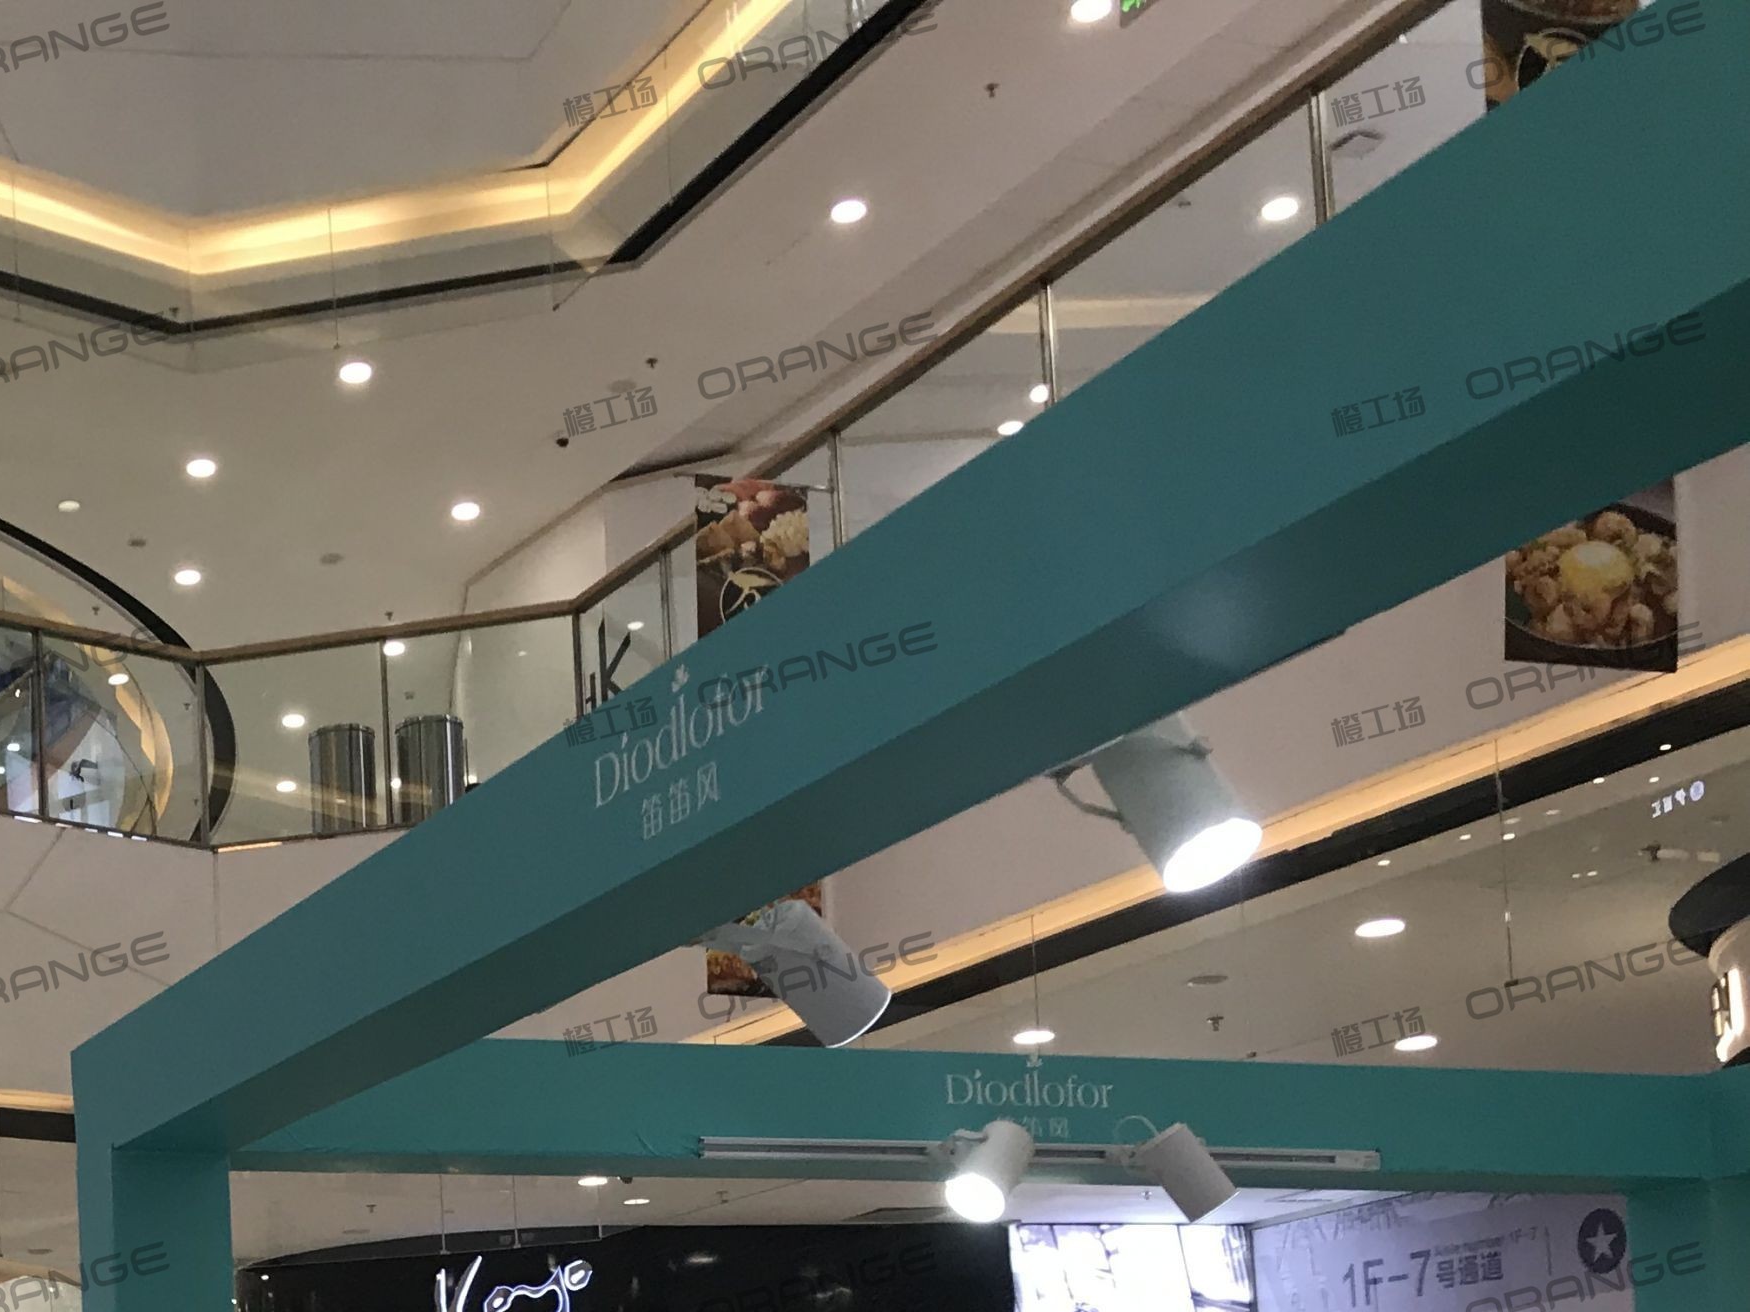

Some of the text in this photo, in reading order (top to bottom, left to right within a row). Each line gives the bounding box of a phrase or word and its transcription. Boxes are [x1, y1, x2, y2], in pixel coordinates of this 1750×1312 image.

[594, 665, 768, 808] Diodlofor
[946, 1068, 1113, 1108] Diodlofor
[1342, 1248, 1504, 1308] 1F-7号通道
